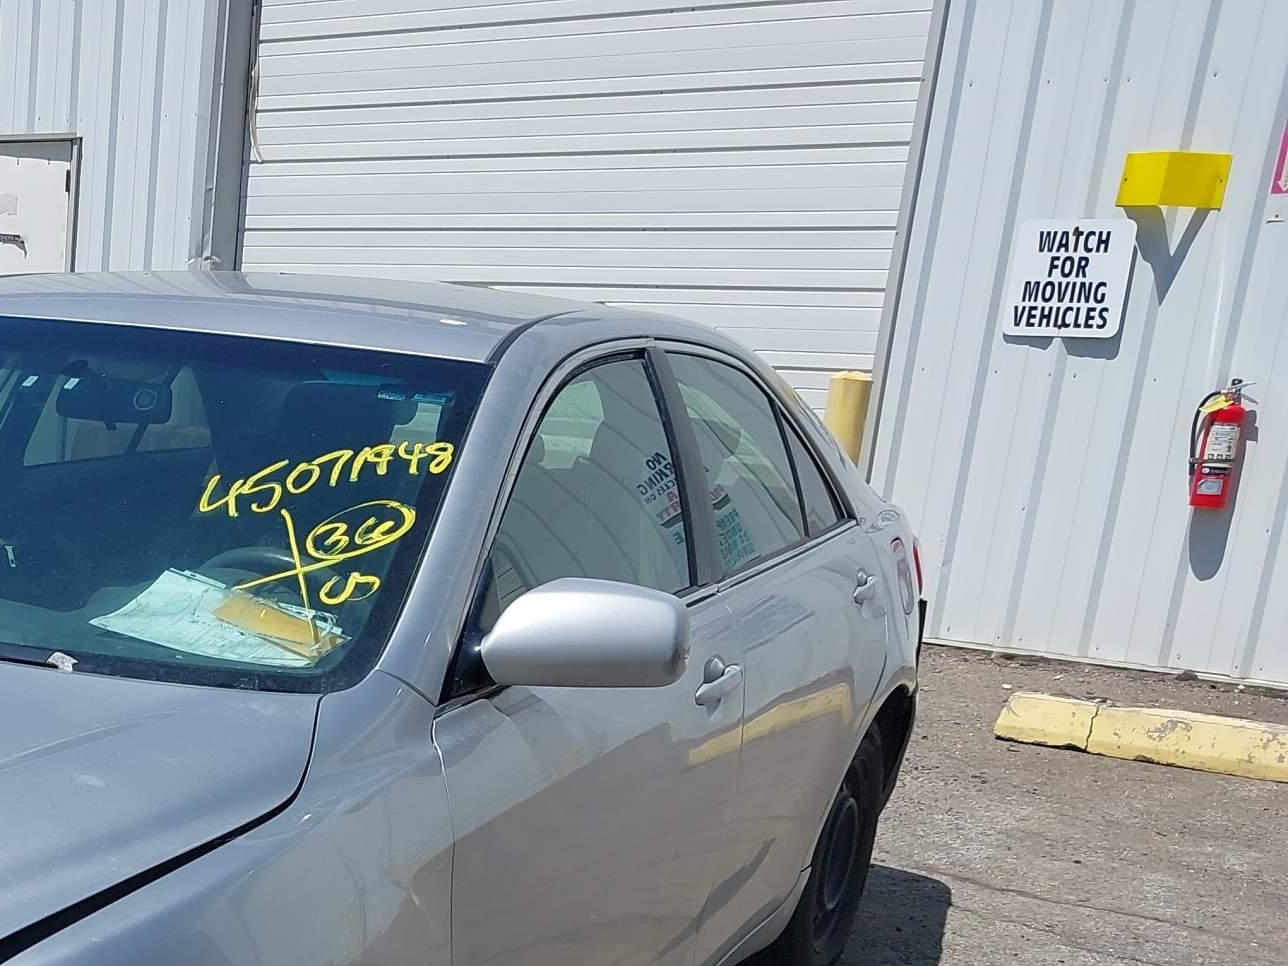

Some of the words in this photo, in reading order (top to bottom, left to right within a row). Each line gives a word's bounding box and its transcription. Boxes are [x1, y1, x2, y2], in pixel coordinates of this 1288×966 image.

[1038, 228, 1112, 254] WATCH
[1047, 255, 1090, 279] FOR
[1021, 280, 1108, 304] MOVING
[1013, 305, 1110, 330] VEHICLES
[198, 441, 455, 518] 45071948
